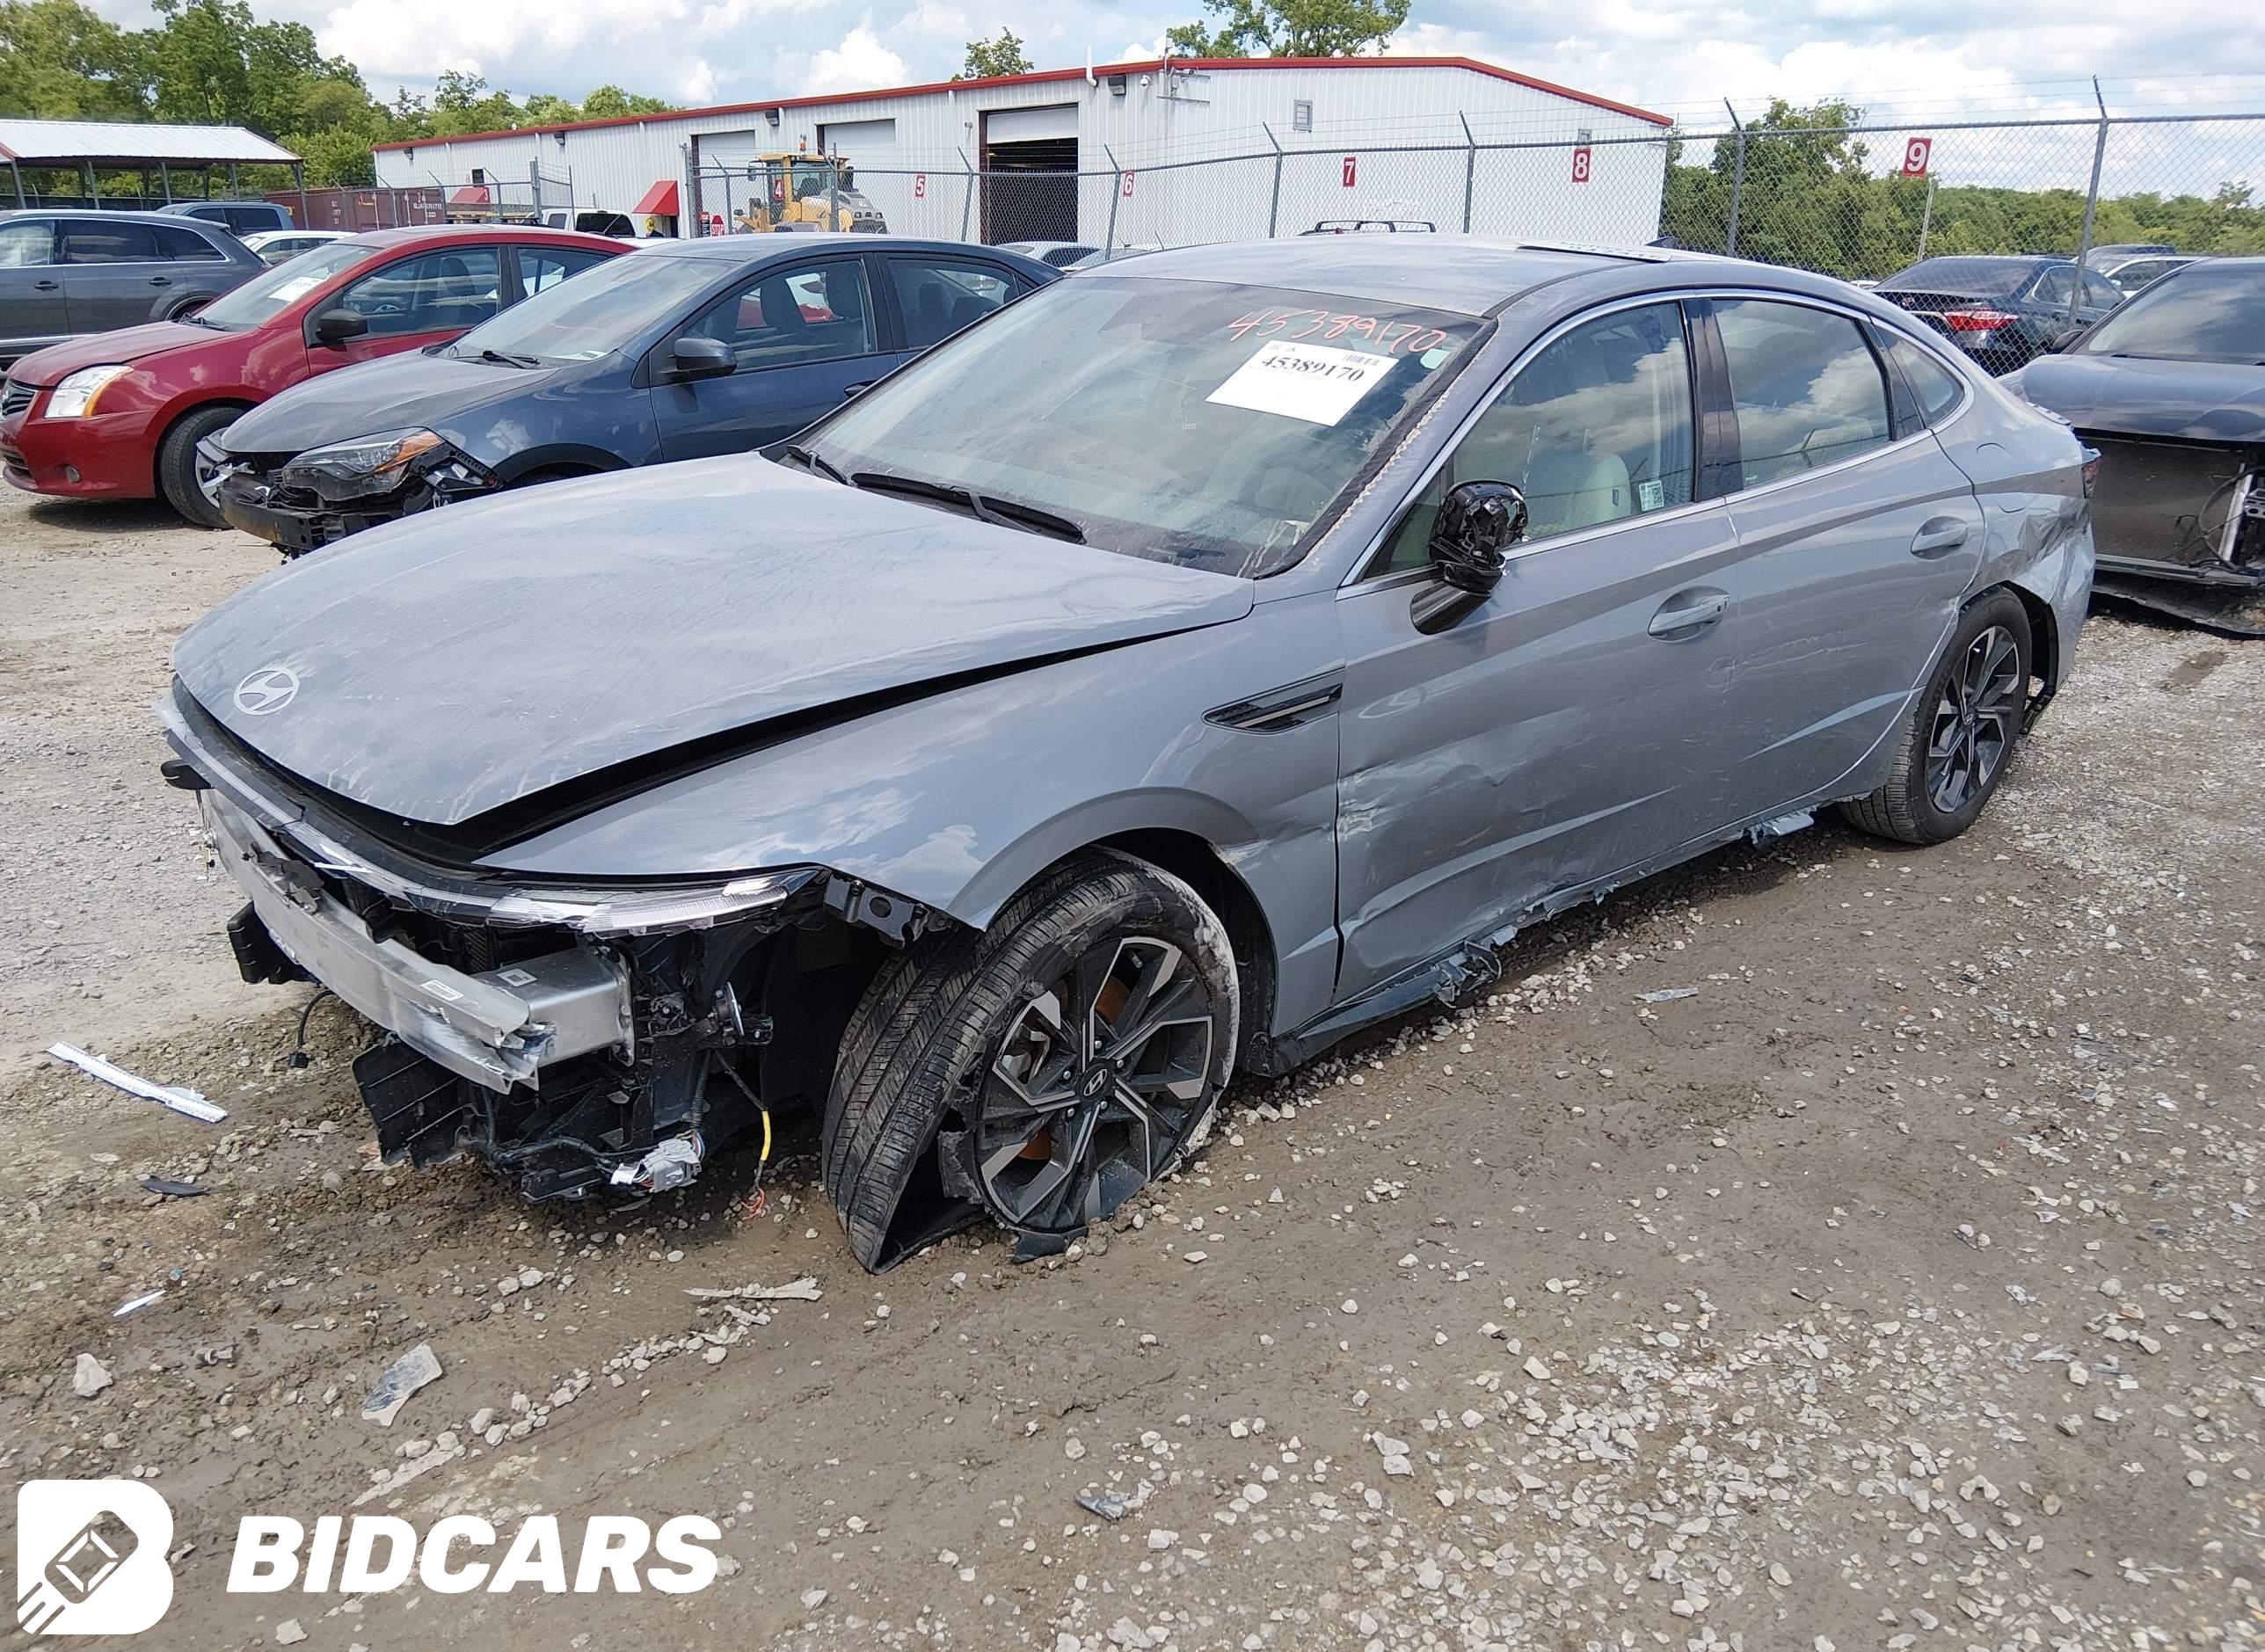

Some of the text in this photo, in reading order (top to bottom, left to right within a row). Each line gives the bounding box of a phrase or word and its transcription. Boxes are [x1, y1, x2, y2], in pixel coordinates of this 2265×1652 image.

[1574, 152, 1588, 179] 8
[1907, 142, 1927, 172] 9
[1125, 174, 1133, 194] 6
[1344, 161, 1355, 184] 7
[775, 180, 783, 198] 4
[916, 177, 924, 195] 5
[711, 223, 725, 236] STOP
[1227, 309, 1448, 354] 45389170
[1261, 355, 1365, 382] 45389170
